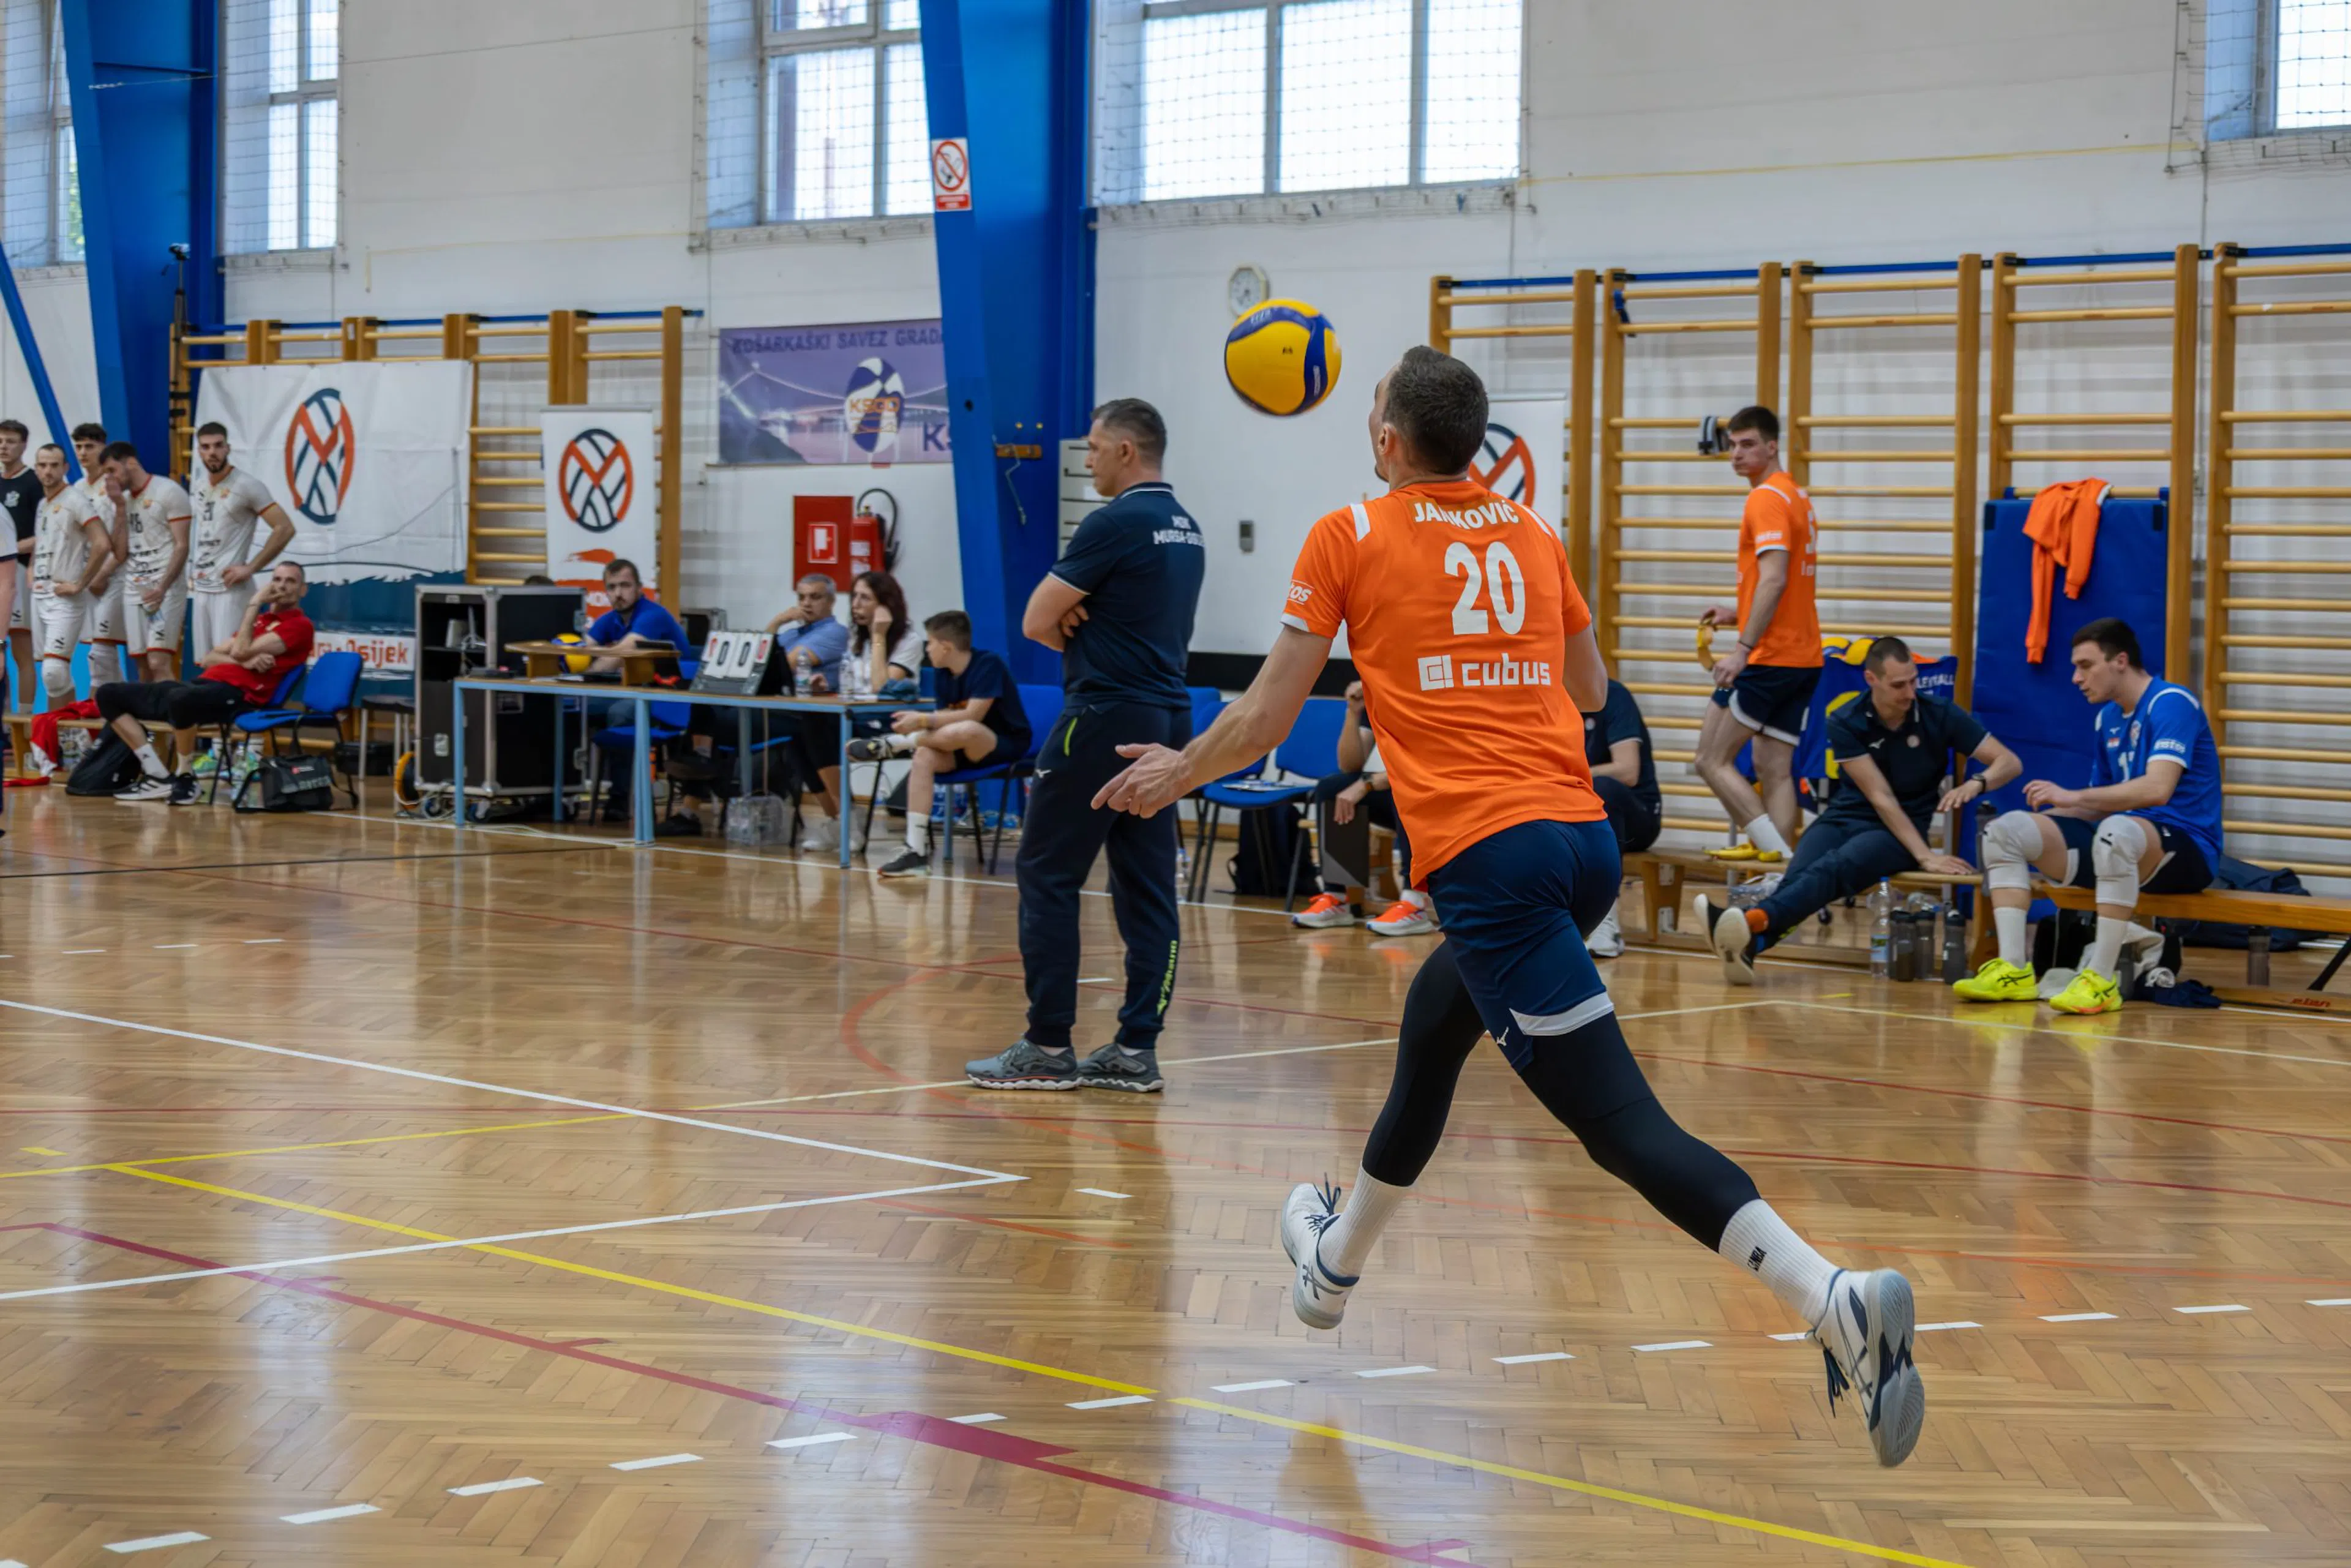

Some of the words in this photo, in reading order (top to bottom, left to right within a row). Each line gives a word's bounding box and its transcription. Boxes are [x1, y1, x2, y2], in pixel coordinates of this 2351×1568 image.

[837, 330, 889, 350] SAVEZ
[1445, 541, 1526, 635] 20
[1461, 653, 1551, 686] cubus
